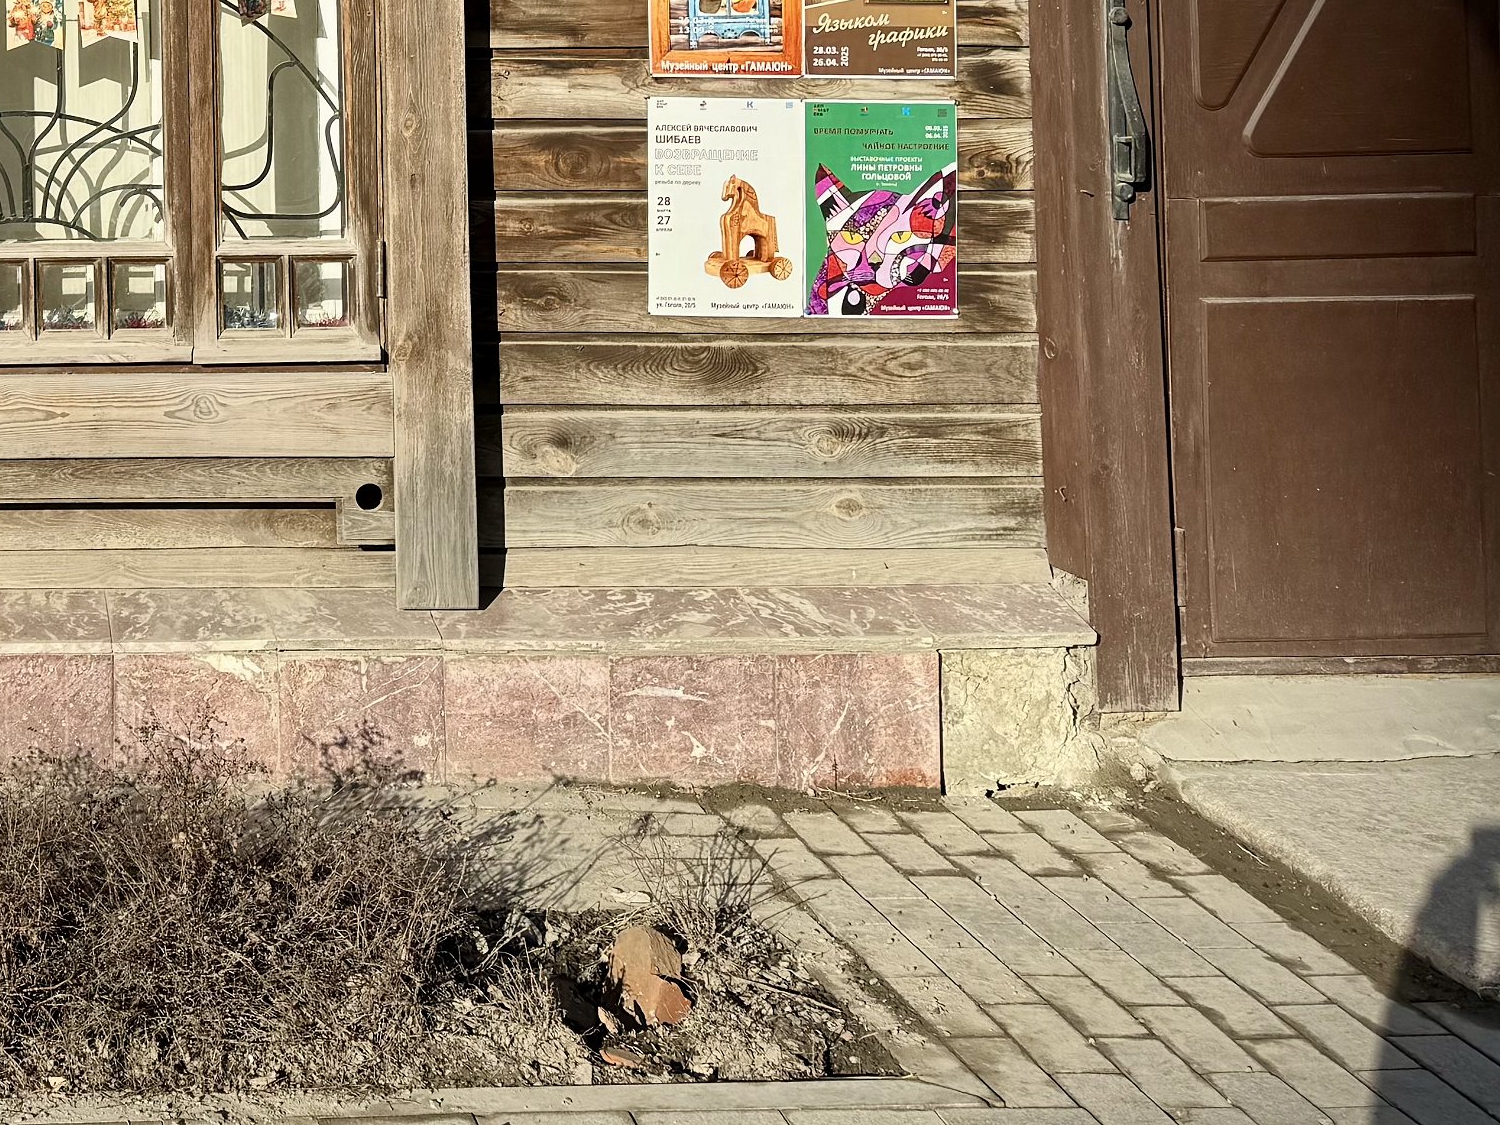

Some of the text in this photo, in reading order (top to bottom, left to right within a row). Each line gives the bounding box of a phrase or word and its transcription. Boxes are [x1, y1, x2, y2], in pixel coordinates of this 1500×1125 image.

[813, 13, 890, 34] Языком
[868, 26, 948, 51] графики
[813, 46, 839, 54] 28.03.
[840, 46, 849, 66] 2025
[661, 60, 792, 73] Музейный центр «ГАМАЮН»
[813, 58, 839, 66] 26.04.
[655, 135, 701, 144] ШИБАЕВ
[863, 142, 895, 150] ЧАЙНОЕ
[655, 148, 758, 162] ВОЗВРАЩЕНИЕ
[655, 164, 702, 175] К СЕБЕ
[861, 172, 911, 181] ГОЛЬЦОВОЙ
[657, 196, 671, 205] 28
[657, 215, 671, 225] 27
